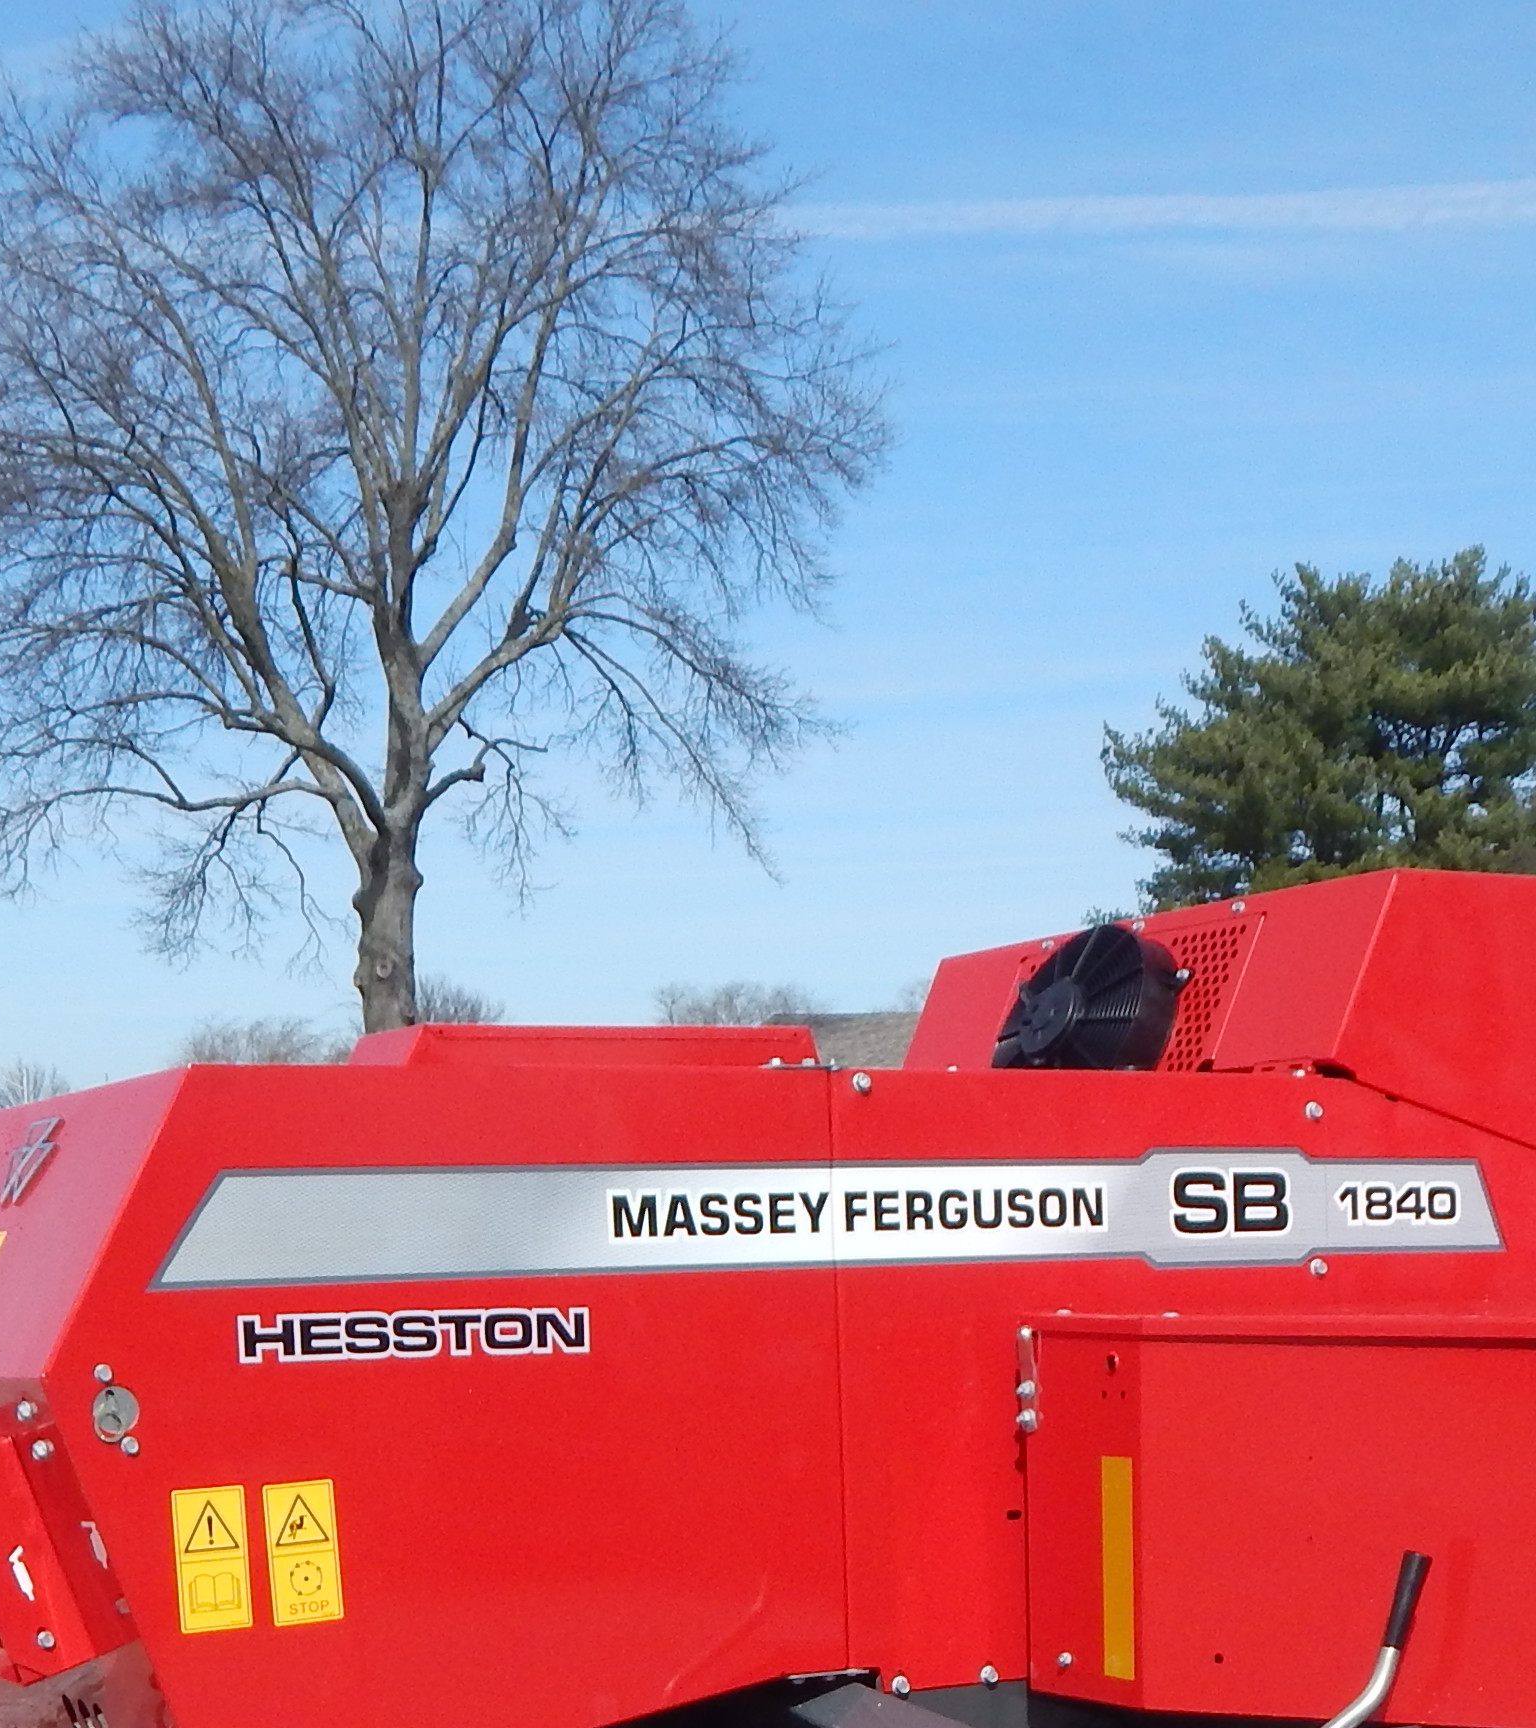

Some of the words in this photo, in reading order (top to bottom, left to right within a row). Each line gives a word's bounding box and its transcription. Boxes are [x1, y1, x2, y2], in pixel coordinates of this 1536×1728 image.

[611, 1191, 830, 1238] MASSEY
[843, 1186, 1104, 1232] FERGUSON
[1172, 1171, 1289, 1234] SB
[1338, 1185, 1458, 1221] 1840
[242, 1311, 586, 1358] HESSTON
[288, 1599, 330, 1616] STOP
